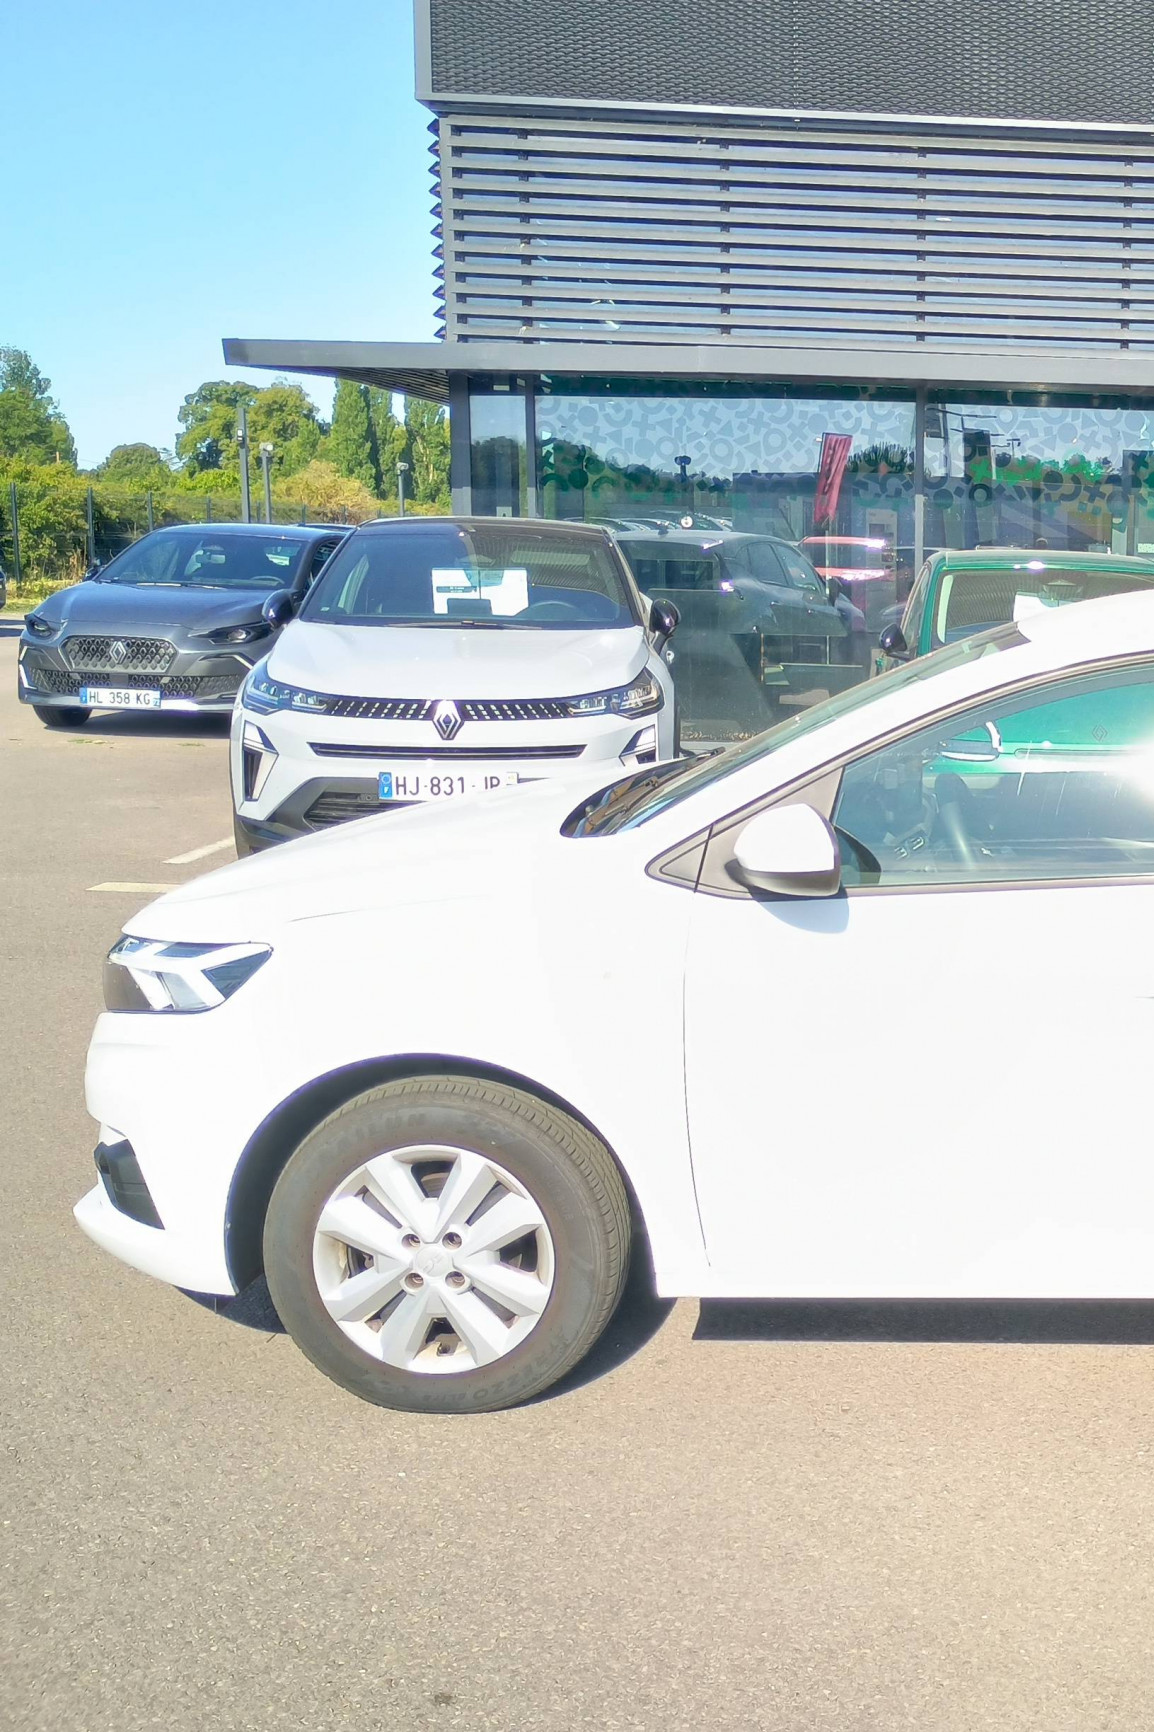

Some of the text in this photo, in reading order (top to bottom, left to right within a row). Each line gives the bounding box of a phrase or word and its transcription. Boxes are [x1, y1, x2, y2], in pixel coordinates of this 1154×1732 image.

[89, 691, 103, 703] HL
[109, 692, 130, 704] 358
[136, 693, 151, 705] KG
